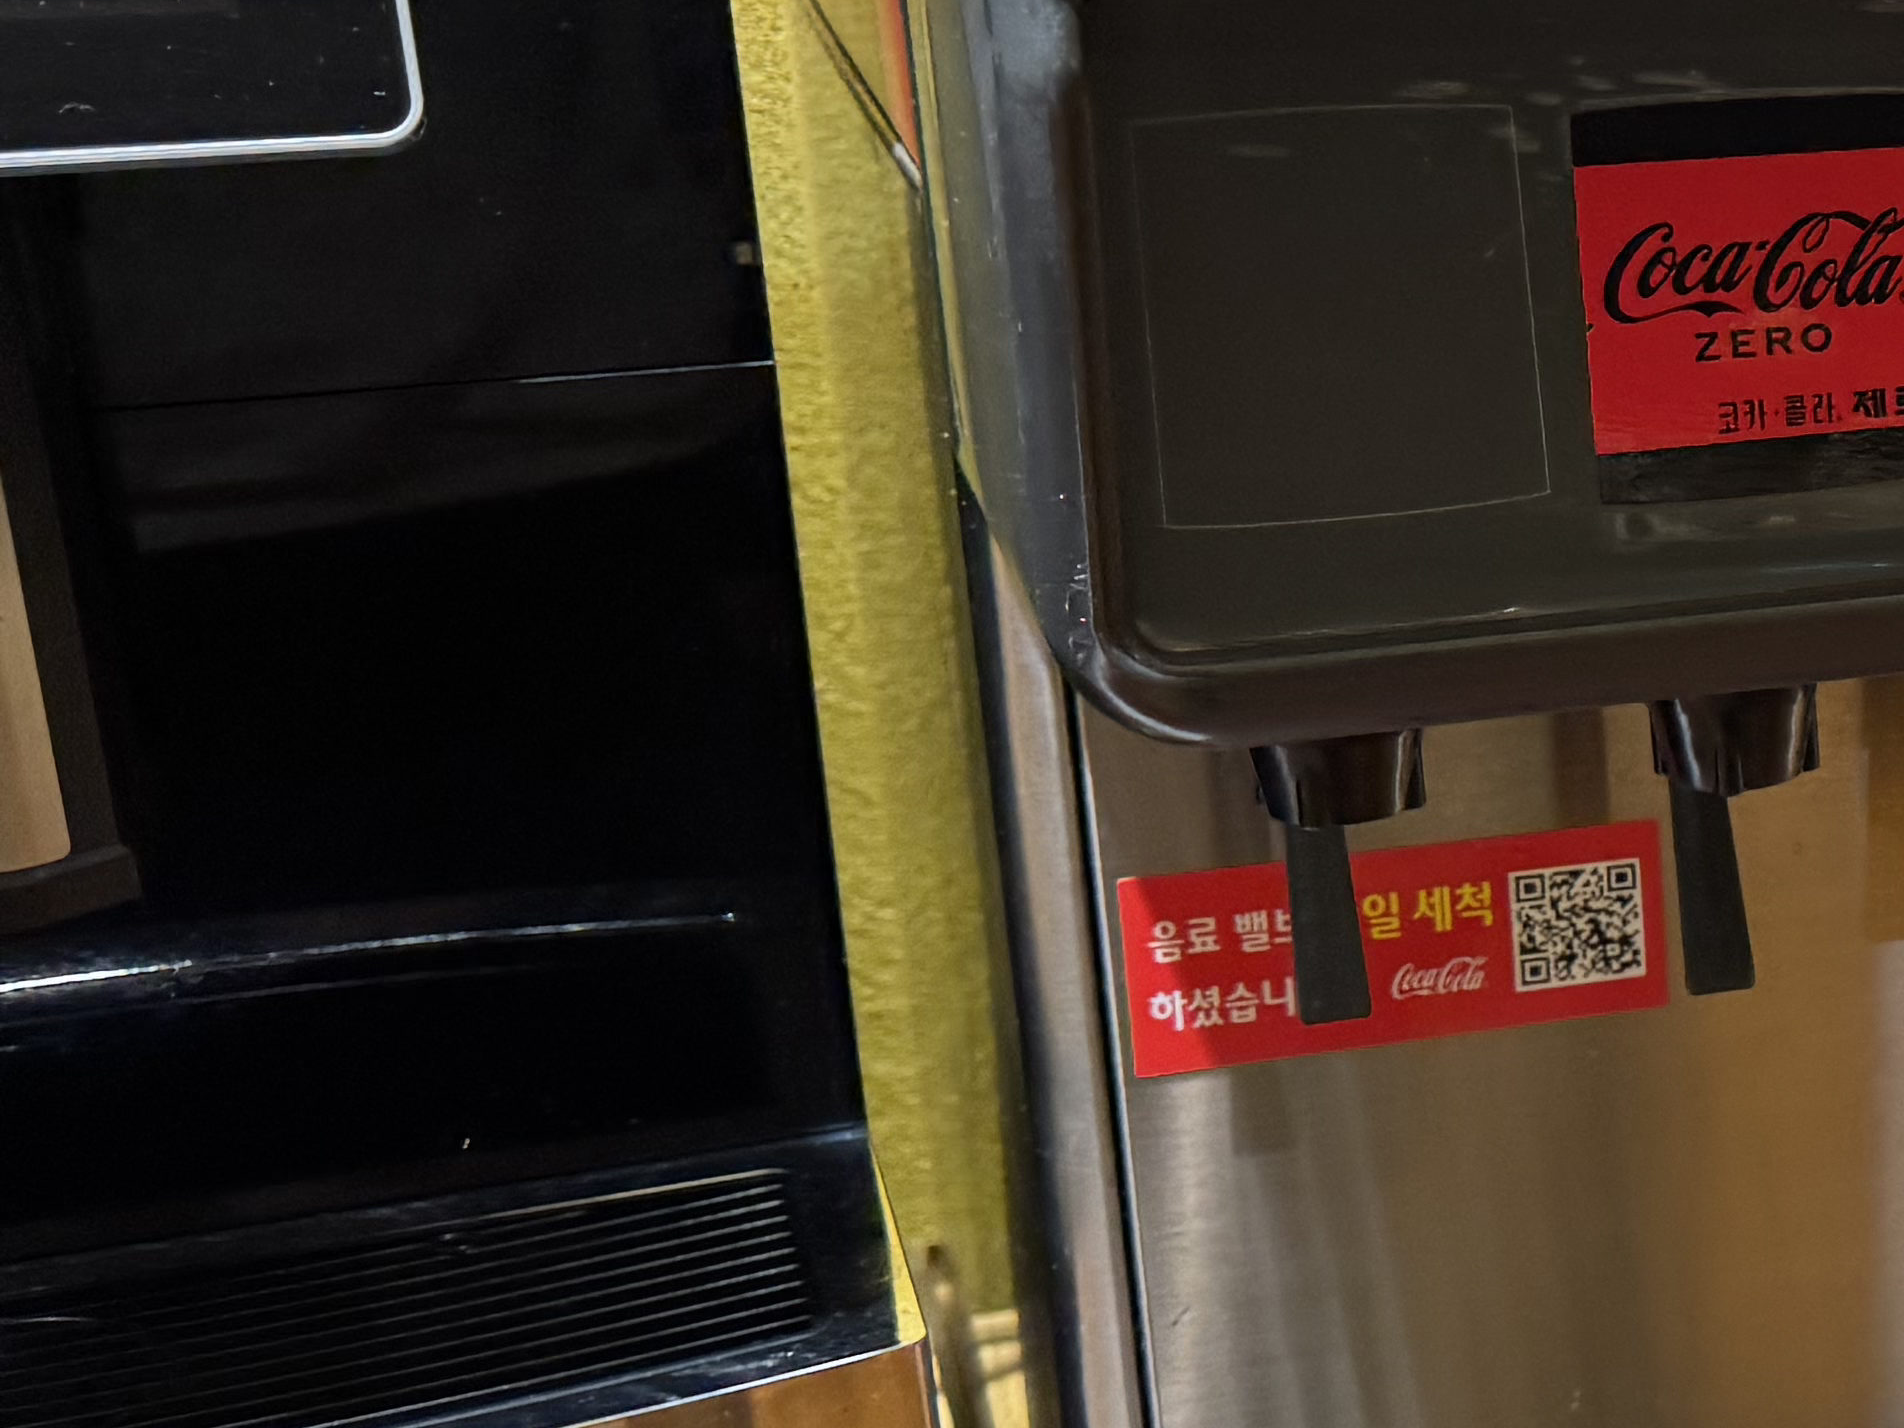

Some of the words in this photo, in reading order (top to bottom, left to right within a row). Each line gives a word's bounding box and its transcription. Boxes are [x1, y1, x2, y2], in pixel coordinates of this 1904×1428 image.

[1694, 323, 1833, 363] ZERO
[1147, 916, 1222, 964] 음료
[1362, 890, 1402, 940] 일
[1413, 880, 1494, 933] 세척
[1391, 956, 1489, 1000] Coca-Cola
[1147, 975, 1298, 1032] 하셨습니
